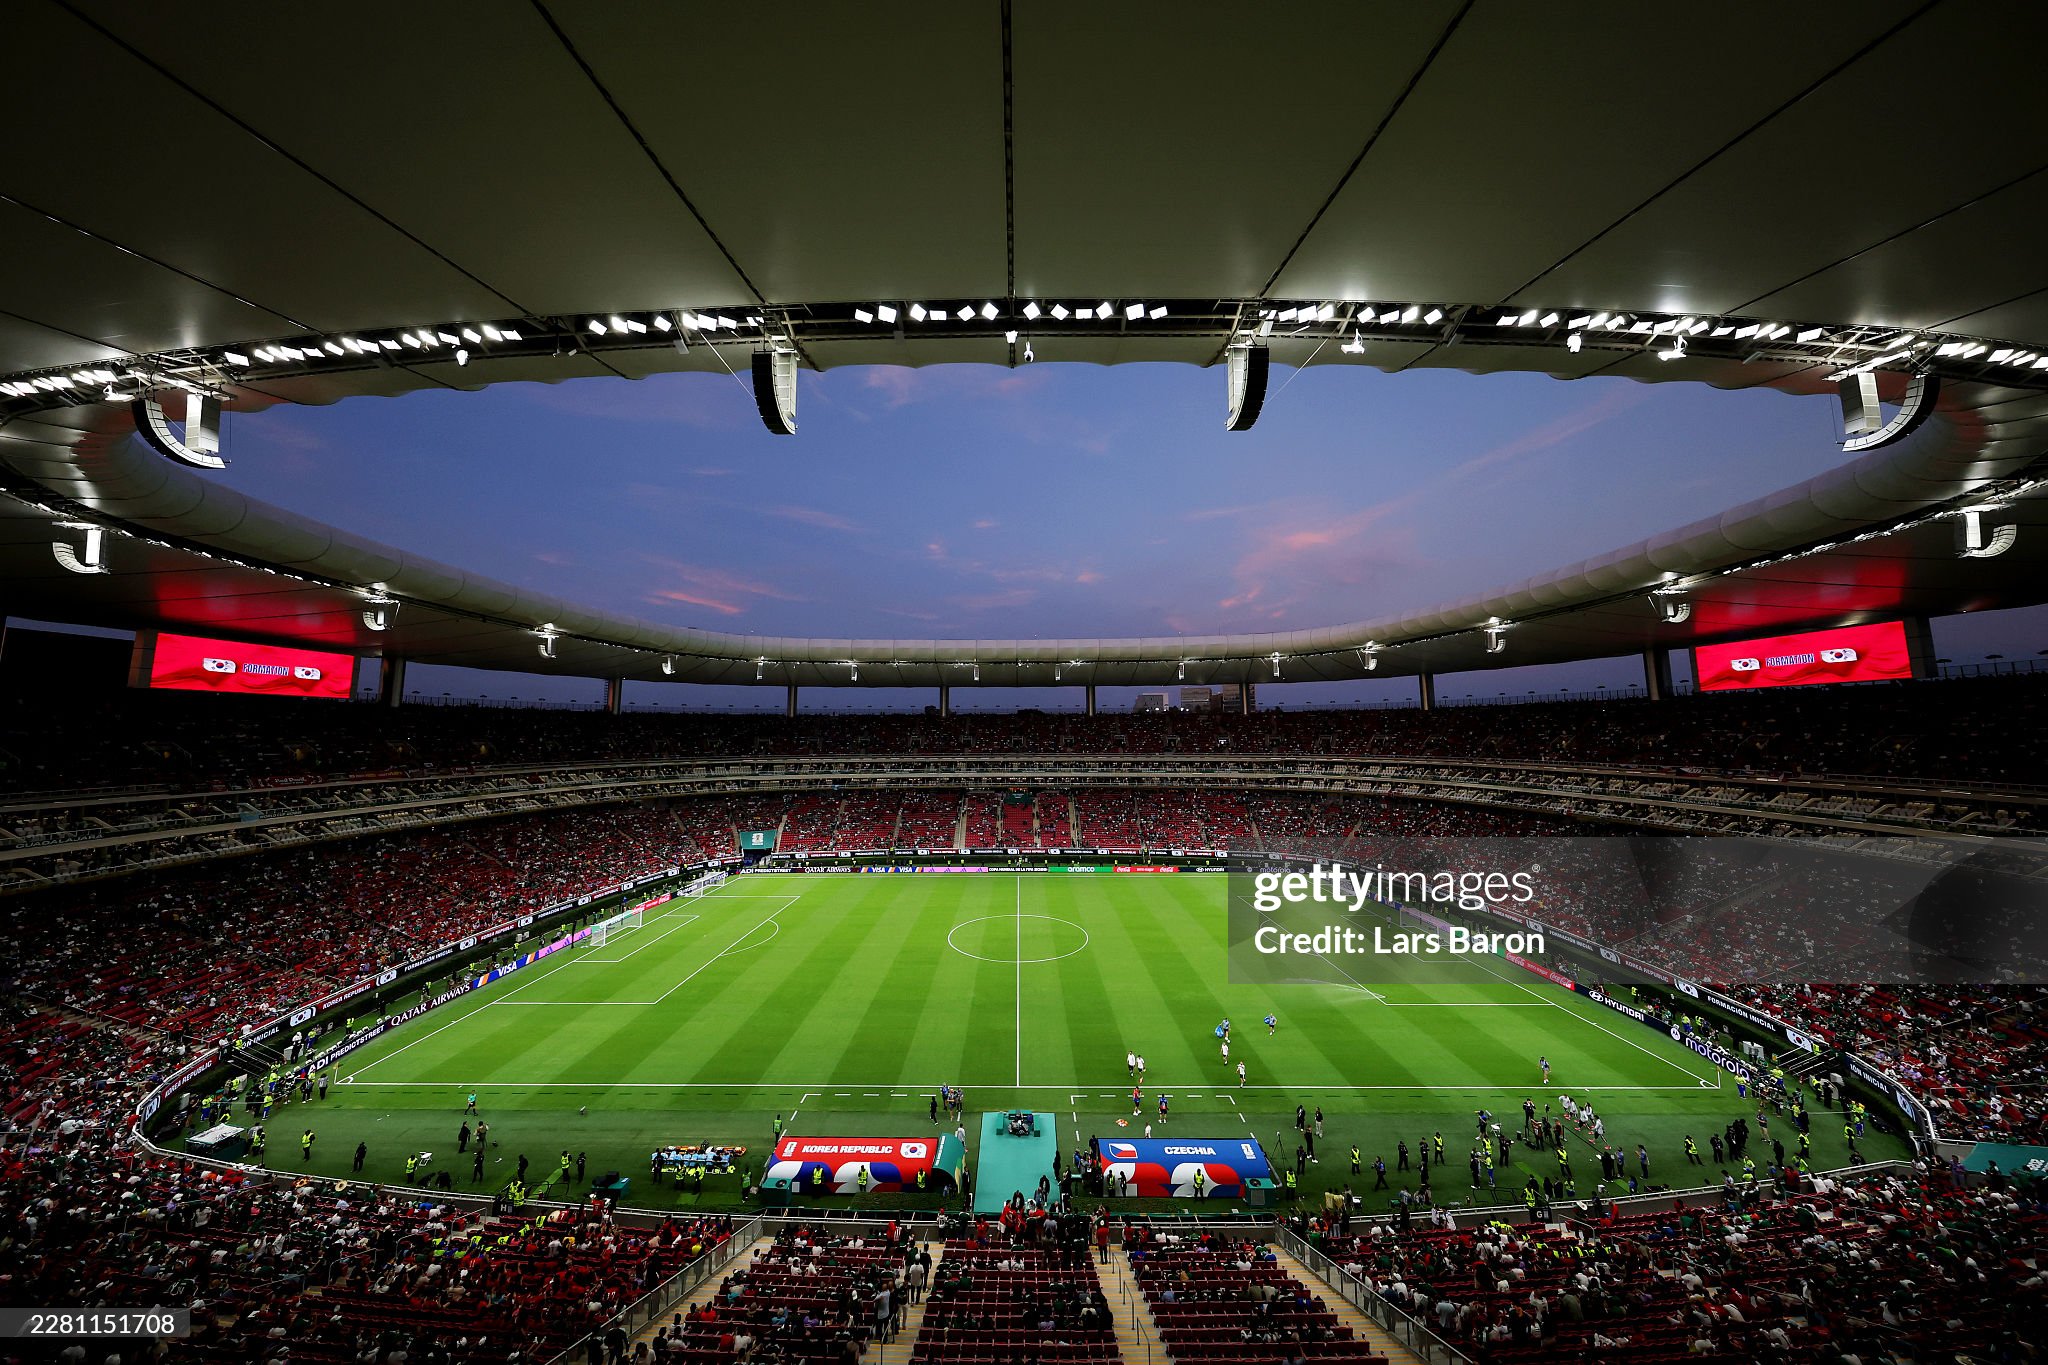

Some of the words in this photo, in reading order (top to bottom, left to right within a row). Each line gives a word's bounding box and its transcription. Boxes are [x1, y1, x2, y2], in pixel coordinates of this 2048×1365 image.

[1765, 653, 1815, 667] FORMATION
[242, 663, 289, 677] FORMATION
[436, 948, 453, 959] INICIAL
[498, 961, 517, 976] VISA
[322, 995, 343, 1009] KOREA
[344, 984, 371, 1000] REPUBLIC
[391, 1003, 427, 1026] QATAR
[430, 983, 471, 1008] AIRWAYS
[1604, 997, 1645, 1022] HYUNDAI
[1749, 1013, 1776, 1032] INICIAL
[253, 1026, 280, 1044] INICIAL
[308, 1056, 329, 1075] ADI
[330, 1025, 385, 1062] PREDICTSTREET
[1685, 1037, 1751, 1081] motorola
[164, 1080, 182, 1098] KOREA
[182, 1060, 213, 1085] REPUBLIC
[802, 1145, 839, 1154] KOREA
[840, 1145, 893, 1154] REPUBLIC
[1164, 1146, 1217, 1156] CZECHIA
[1536, 1211, 1543, 1219] G
